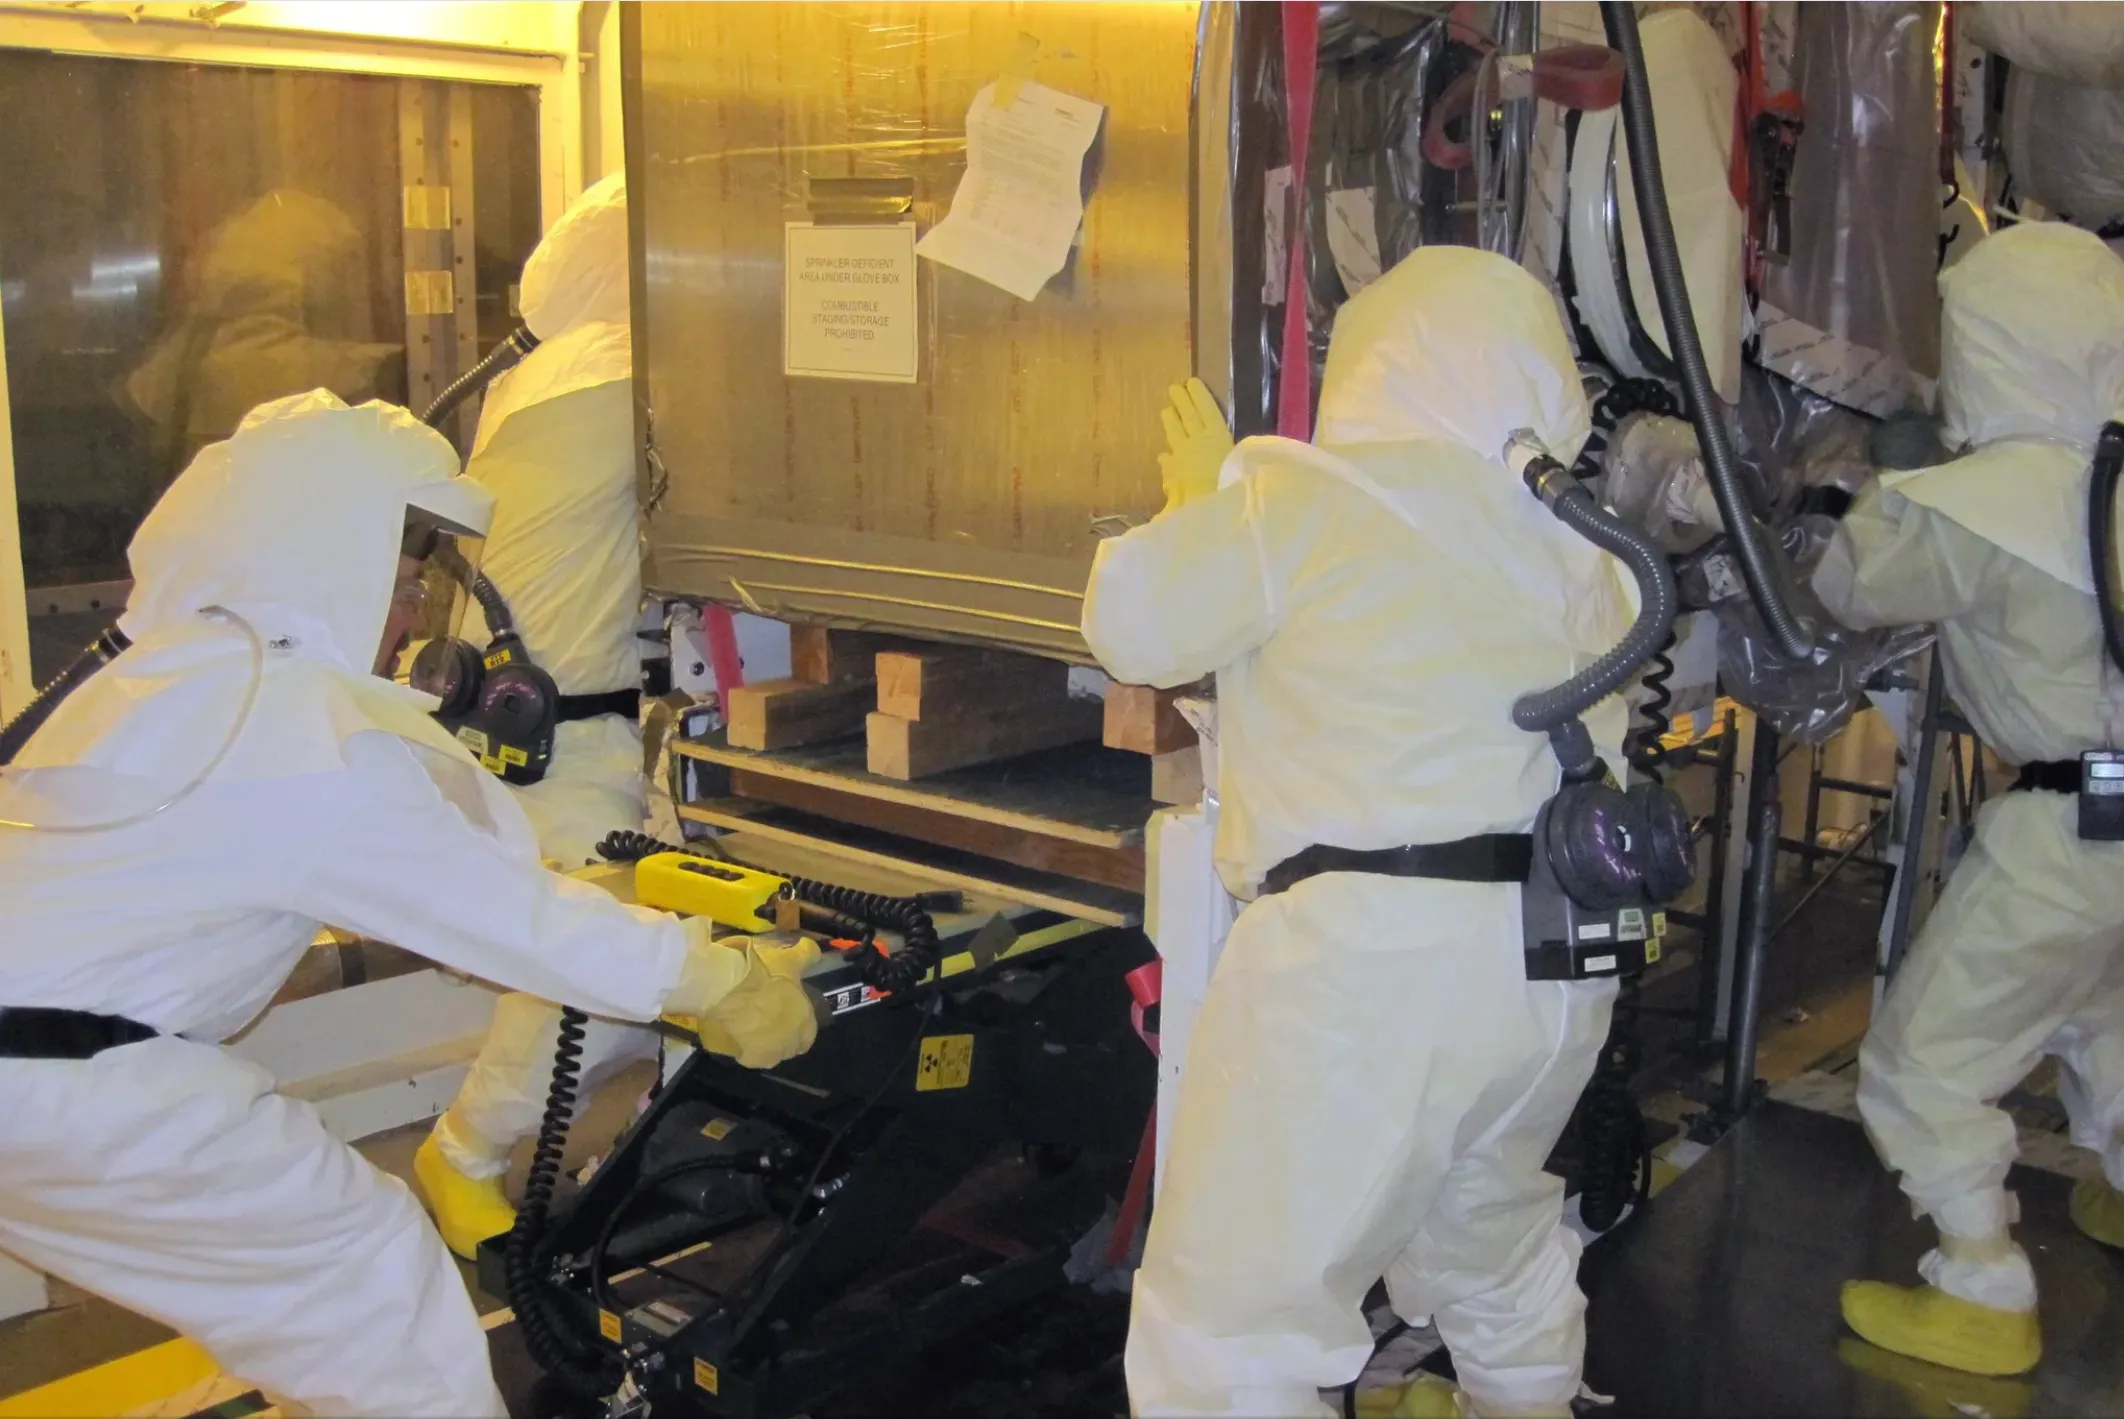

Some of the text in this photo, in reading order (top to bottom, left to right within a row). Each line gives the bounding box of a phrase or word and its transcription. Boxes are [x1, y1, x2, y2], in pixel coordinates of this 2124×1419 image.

[805, 257, 894, 269] SPRINKLER DEFICIENT
[799, 271, 900, 284] AREA UNDER GLOVE BOX
[821, 300, 879, 312] COMBUSTIBLE
[824, 328, 875, 340] PROHIBITED
